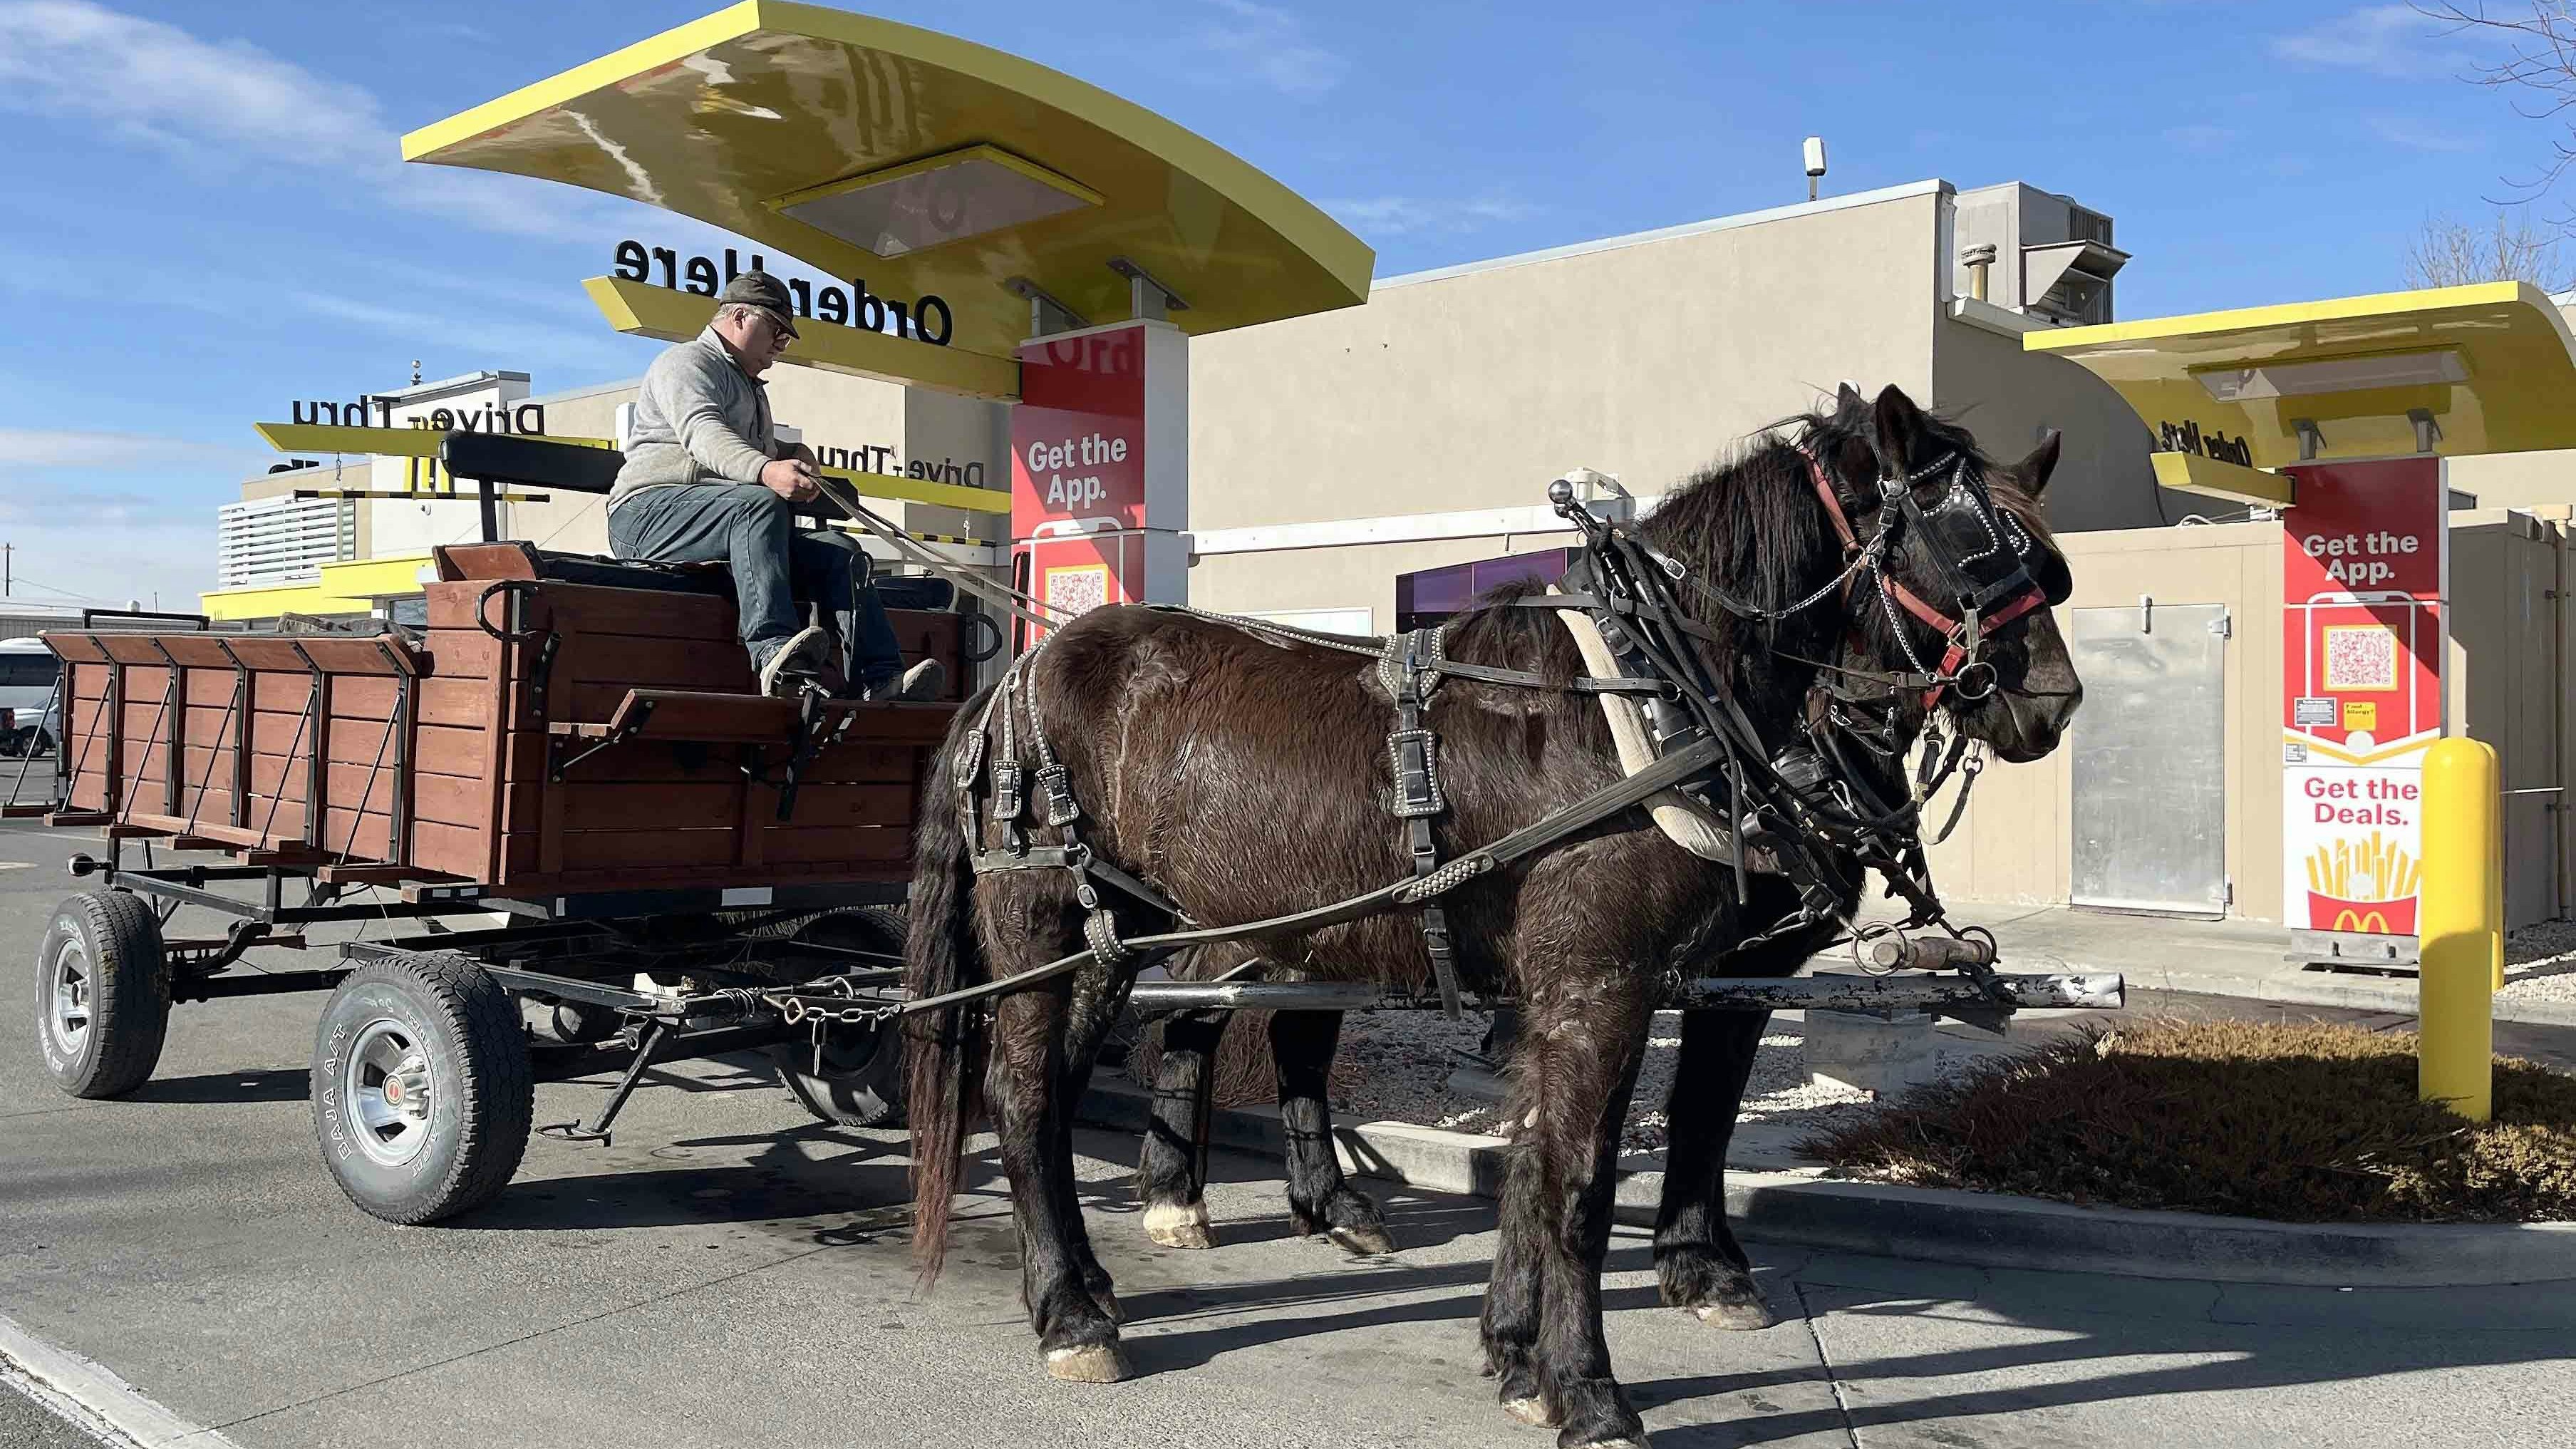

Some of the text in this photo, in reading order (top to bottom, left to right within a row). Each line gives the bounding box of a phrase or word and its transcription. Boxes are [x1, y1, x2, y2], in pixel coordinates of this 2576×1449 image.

[1028, 433, 1127, 472] Get the
[1047, 474, 1107, 511] App.
[2303, 531, 2419, 557] Get the
[2325, 558, 2395, 586] App.
[2305, 777, 2419, 800] Get the
[2315, 803, 2409, 825] Deals.
[323, 1023, 353, 1161] BAJA A/T
